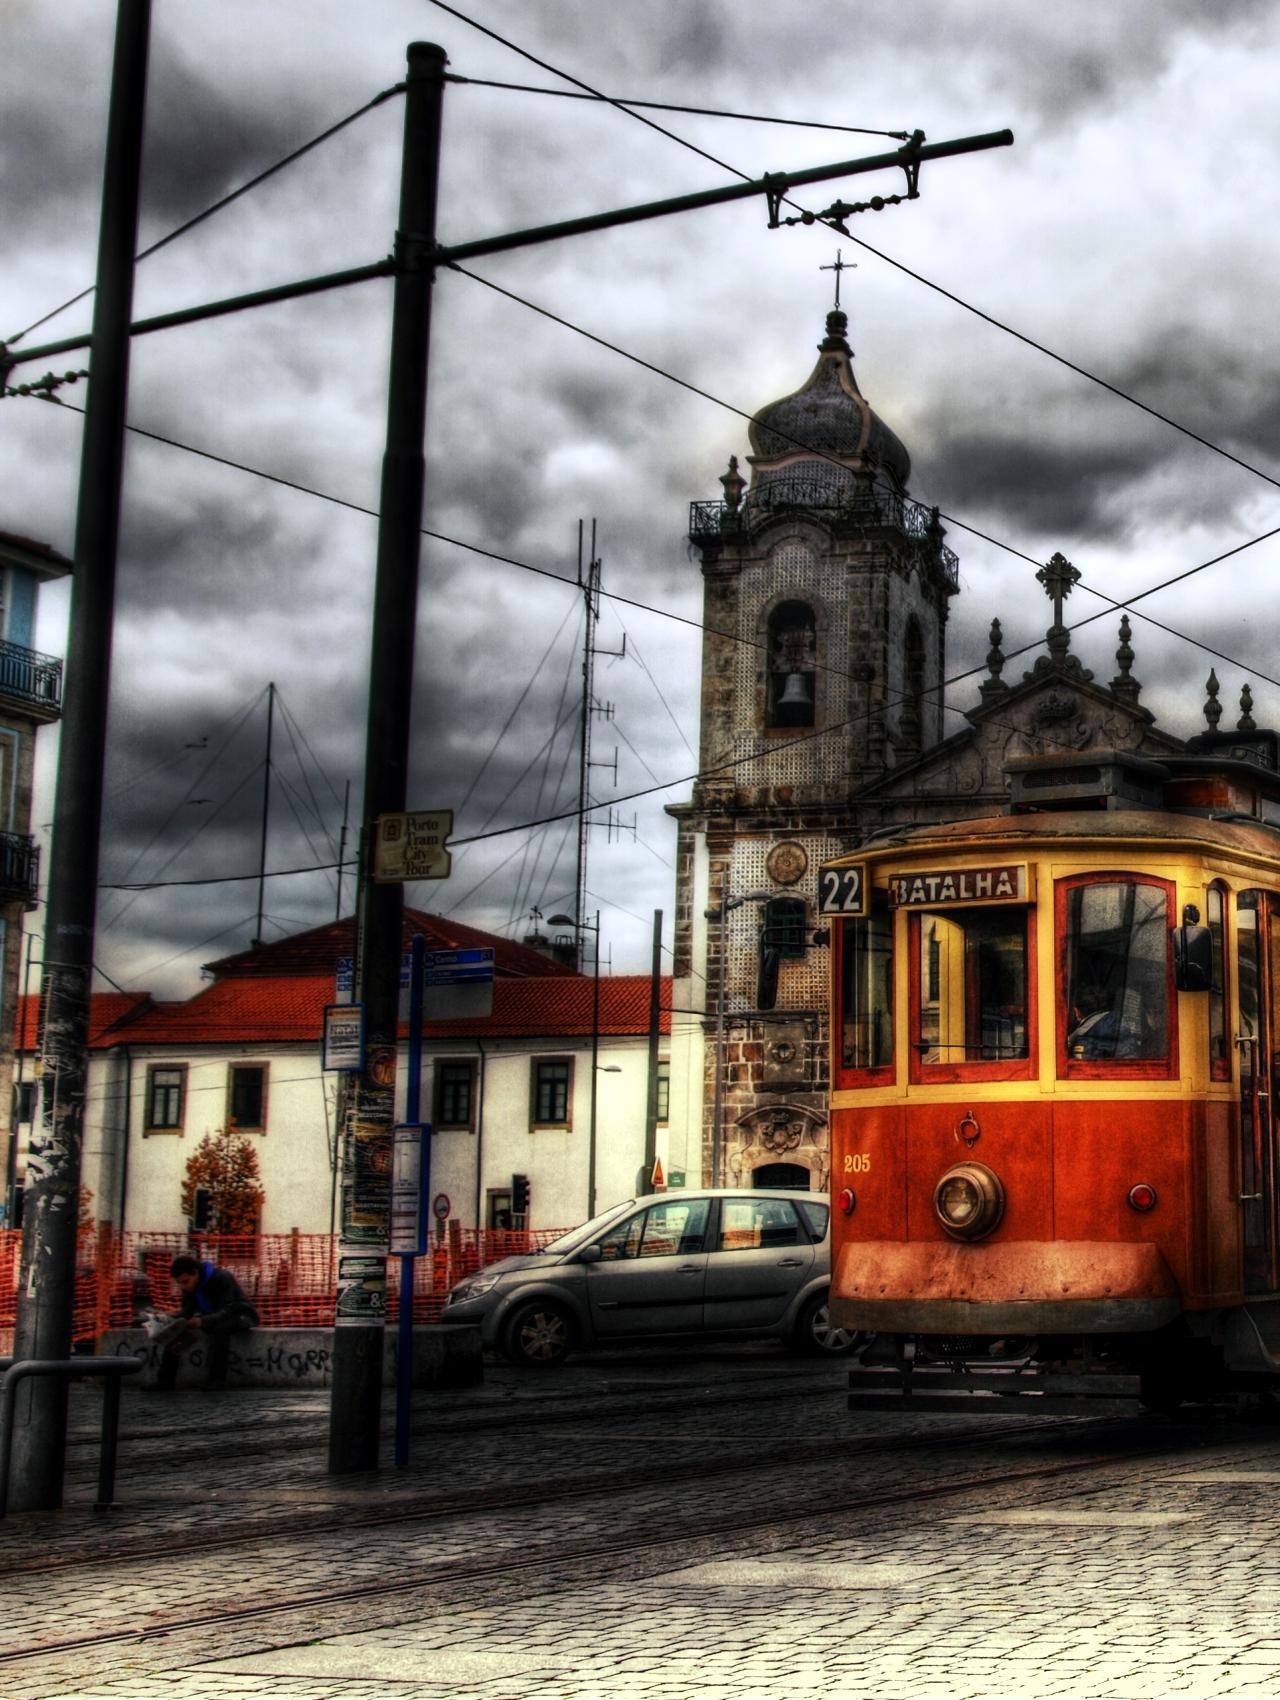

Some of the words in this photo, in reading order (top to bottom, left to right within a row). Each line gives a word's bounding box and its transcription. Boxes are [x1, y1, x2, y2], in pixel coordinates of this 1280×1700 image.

[406, 817, 439, 832] Porto
[404, 832, 439, 846] Tram
[403, 847, 426, 863] City
[402, 861, 432, 875] Tour
[823, 870, 860, 911] 22
[891, 871, 1014, 904] BATALHA
[844, 1153, 871, 1173] 205
